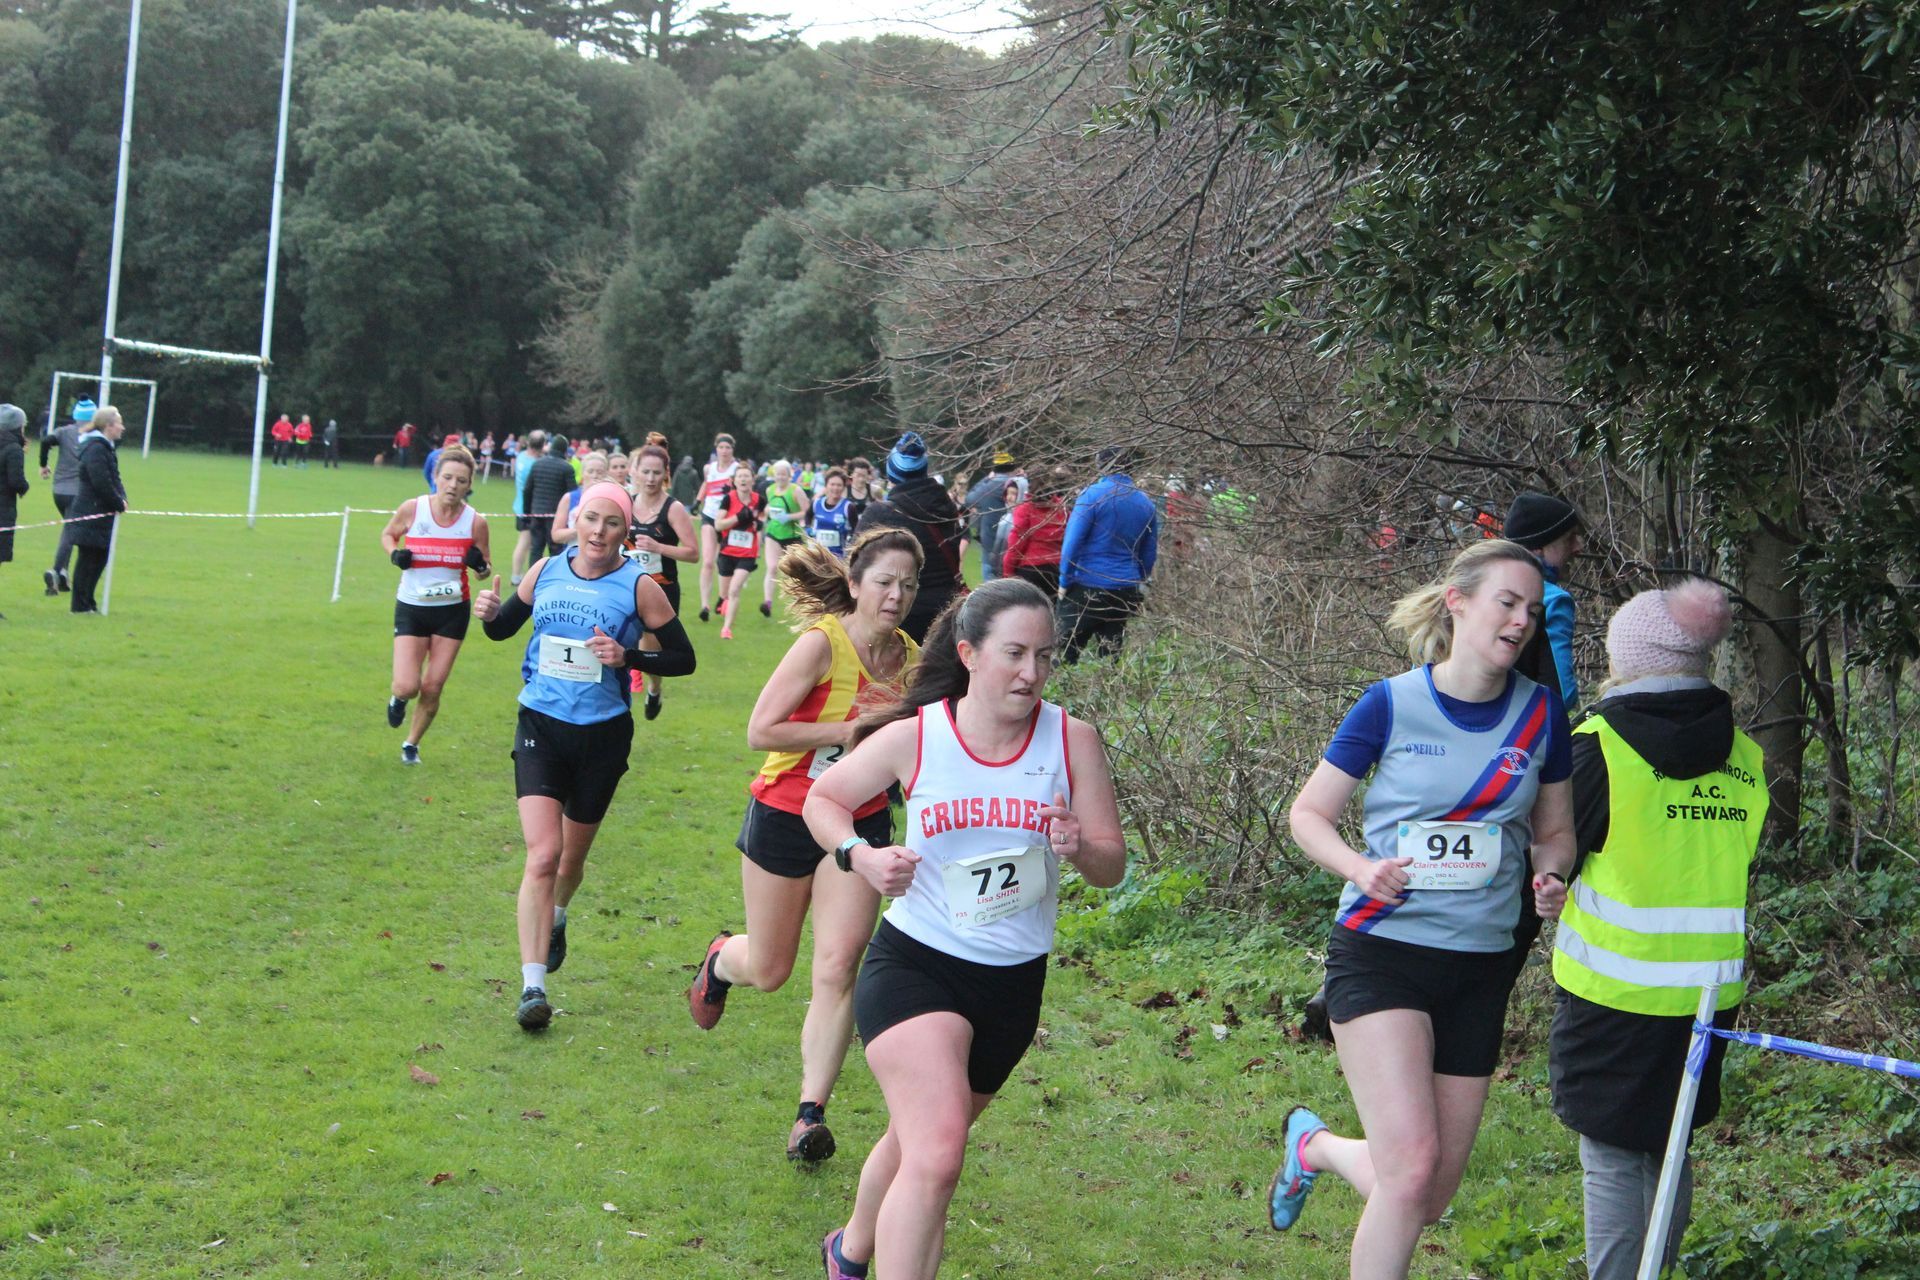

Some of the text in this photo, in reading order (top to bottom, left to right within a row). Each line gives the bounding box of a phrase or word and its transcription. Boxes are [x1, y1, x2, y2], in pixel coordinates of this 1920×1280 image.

[425, 586, 454, 597] 226
[563, 647, 574, 664] 1
[1405, 743, 1446, 757] O'NEILLS
[1691, 784, 1726, 799] A.C.
[1666, 804, 1748, 822] STEWARD
[1426, 833, 1474, 861] 94
[1413, 861, 1488, 869] Claire MCGOVERN
[971, 862, 1019, 896] 72
[977, 886, 1021, 904] Lisa SHINE
